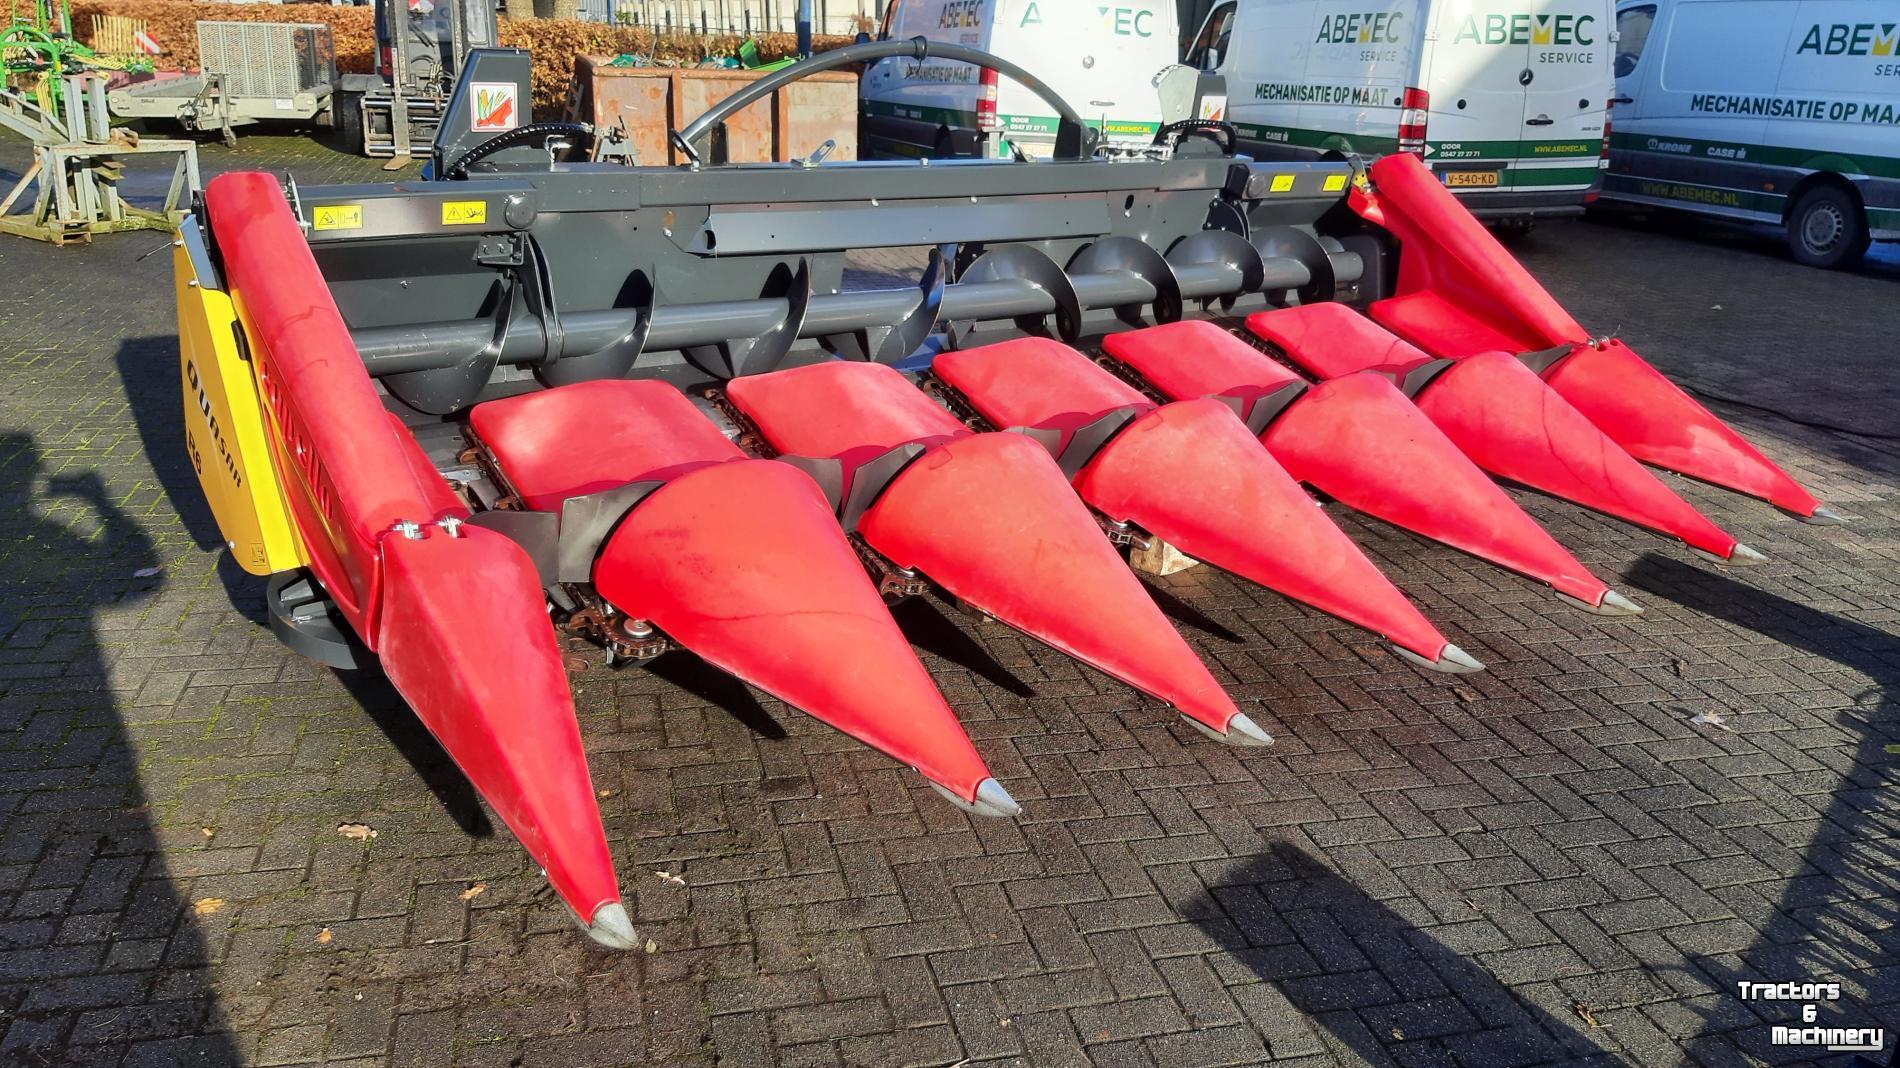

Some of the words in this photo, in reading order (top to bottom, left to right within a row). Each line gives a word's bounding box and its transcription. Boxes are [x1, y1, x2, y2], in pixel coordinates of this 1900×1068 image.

[1316, 12, 1403, 44] ABEMEC
[1453, 14, 1595, 46] ABEMEC
[1360, 51, 1397, 62] SERVICE
[1540, 52, 1593, 64] SERVICE
[1255, 83, 1332, 103] MECHANISATIE
[1333, 86, 1350, 104] OP
[1351, 87, 1389, 106] MAAT
[1690, 94, 1826, 119] MECHANISATIE
[1829, 102, 1858, 121] OP
[1657, 142, 1692, 153] KRONE
[1707, 146, 1735, 157] CASE
[1447, 174, 1495, 185] V-540-KD
[186, 359, 243, 489] QUASAR
